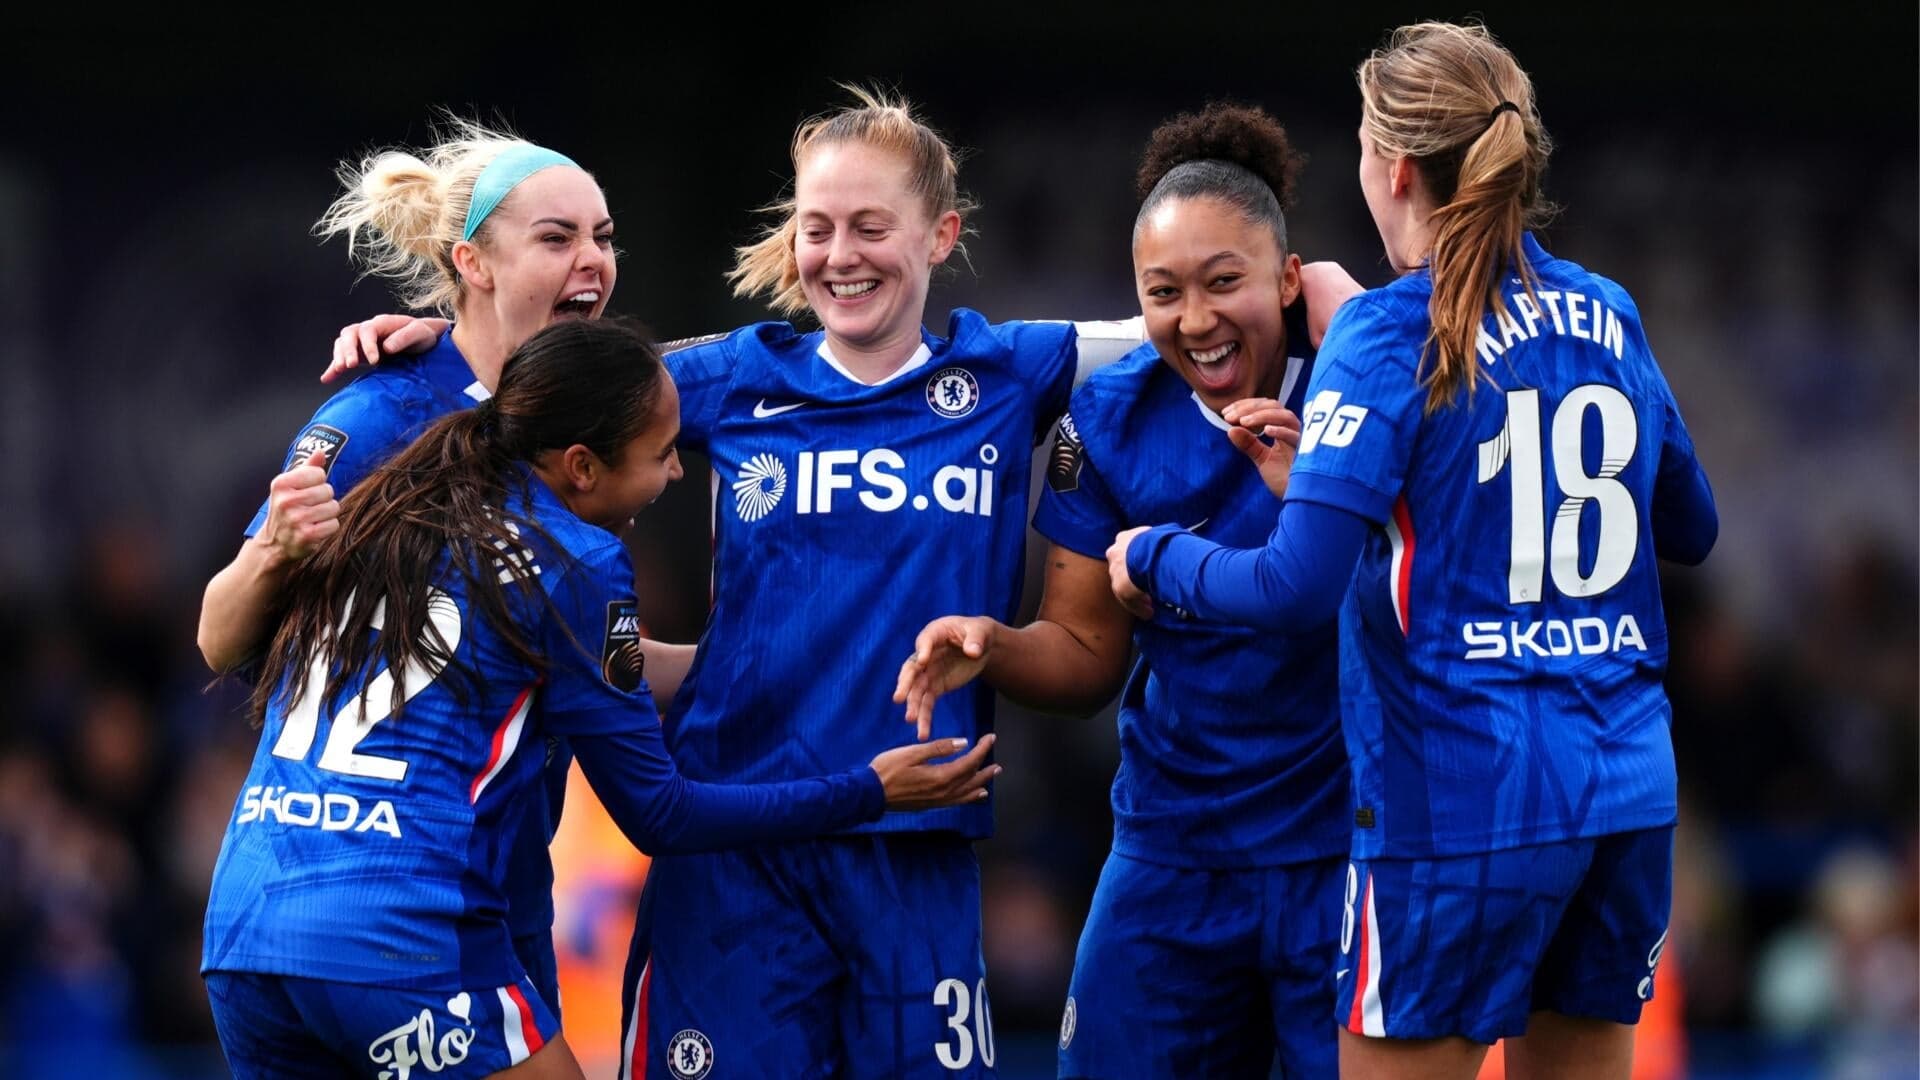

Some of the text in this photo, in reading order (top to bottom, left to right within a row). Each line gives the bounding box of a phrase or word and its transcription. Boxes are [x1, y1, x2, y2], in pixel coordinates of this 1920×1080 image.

[1476, 290, 1624, 366] KAPTEIN
[796, 443, 999, 518] IFS.ai
[1477, 383, 1639, 605] 18
[611, 616, 640, 633] WS
[270, 584, 462, 782] 12
[368, 1007, 476, 1080] Flo
[933, 977, 994, 1070] 30
